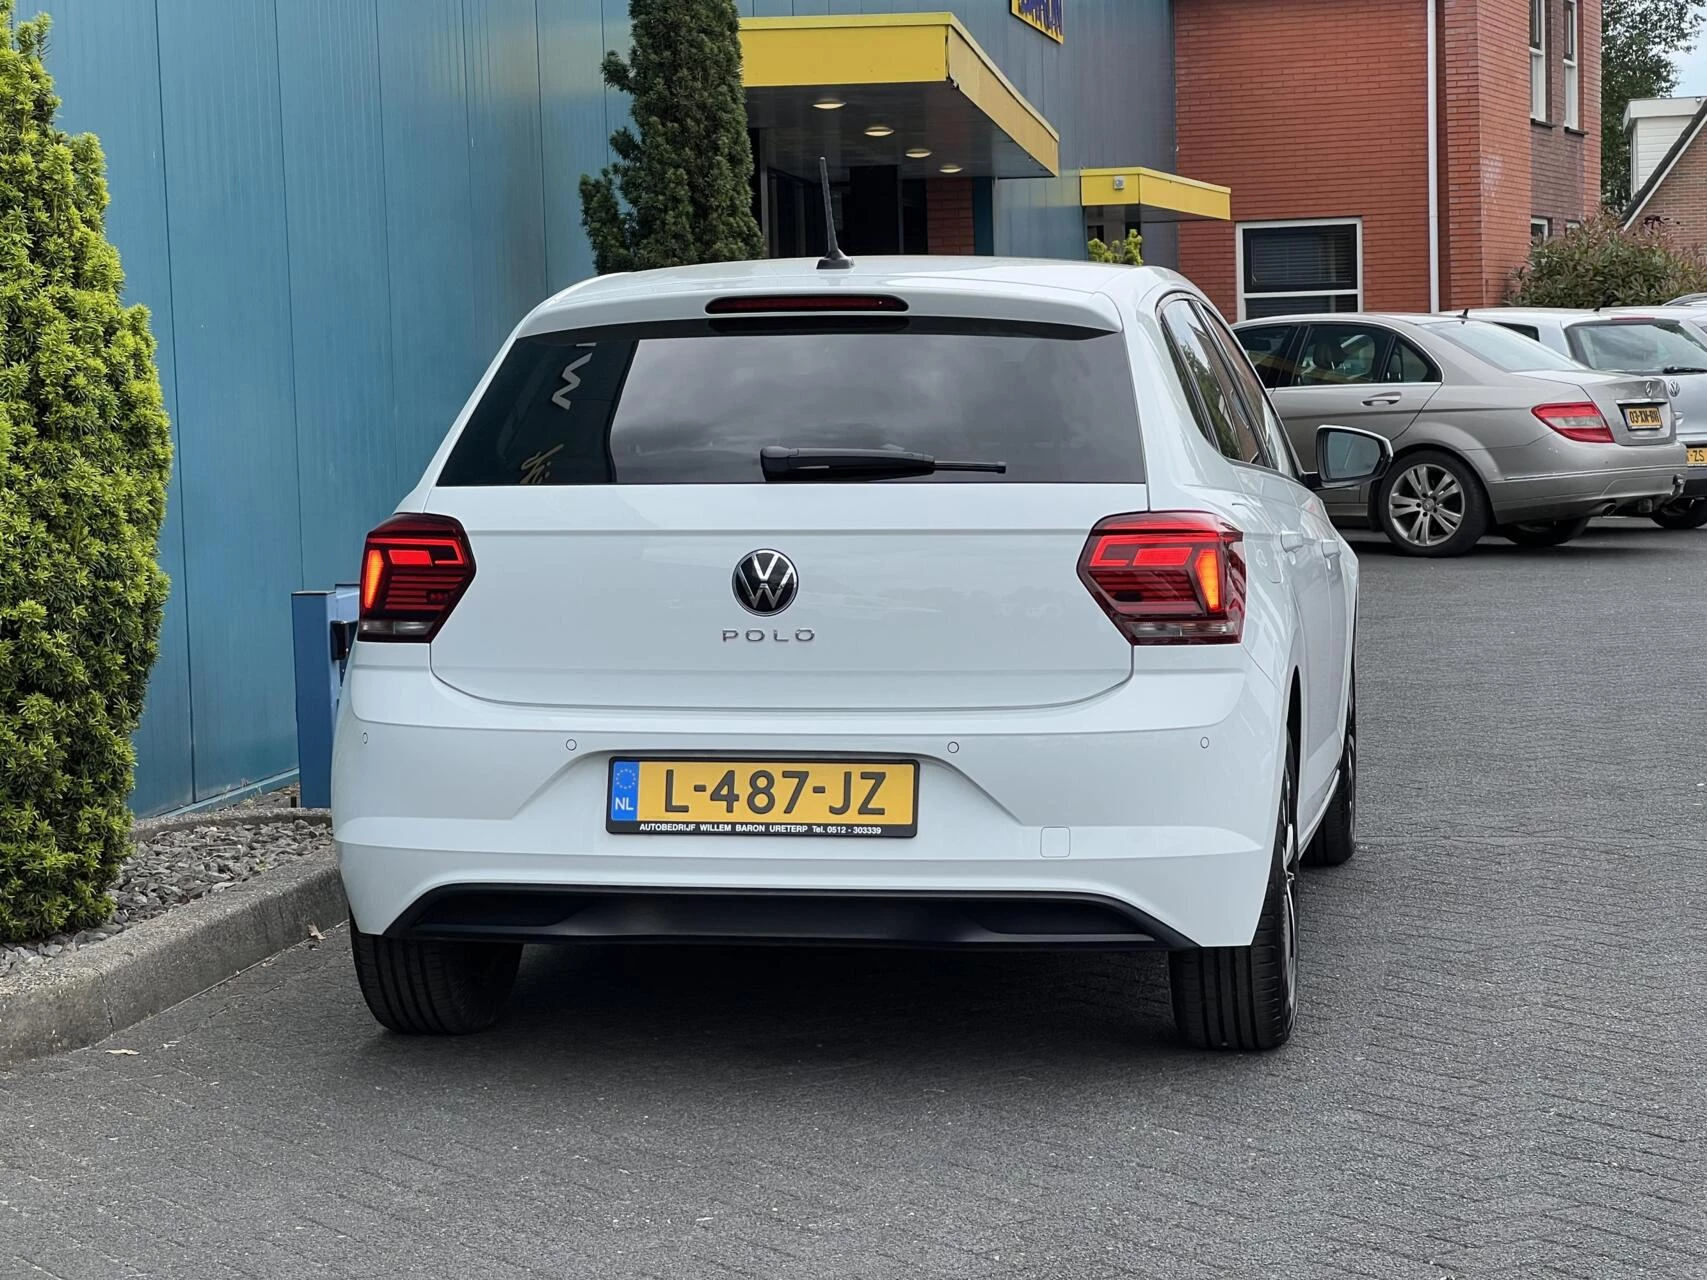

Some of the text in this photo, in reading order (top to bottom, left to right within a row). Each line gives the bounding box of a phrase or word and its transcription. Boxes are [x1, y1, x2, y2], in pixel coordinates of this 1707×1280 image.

[722, 628, 815, 642] POLO
[664, 768, 887, 816] L-487-JZ
[614, 797, 634, 811] NL
[639, 823, 696, 832] AUTOBEDRIJF
[700, 824, 732, 832] WILLEM
[735, 824, 765, 833] BARON
[769, 825, 808, 833] URETERP
[812, 826, 826, 834] Tel.
[827, 826, 846, 834] 0512
[853, 827, 881, 835] 303339
